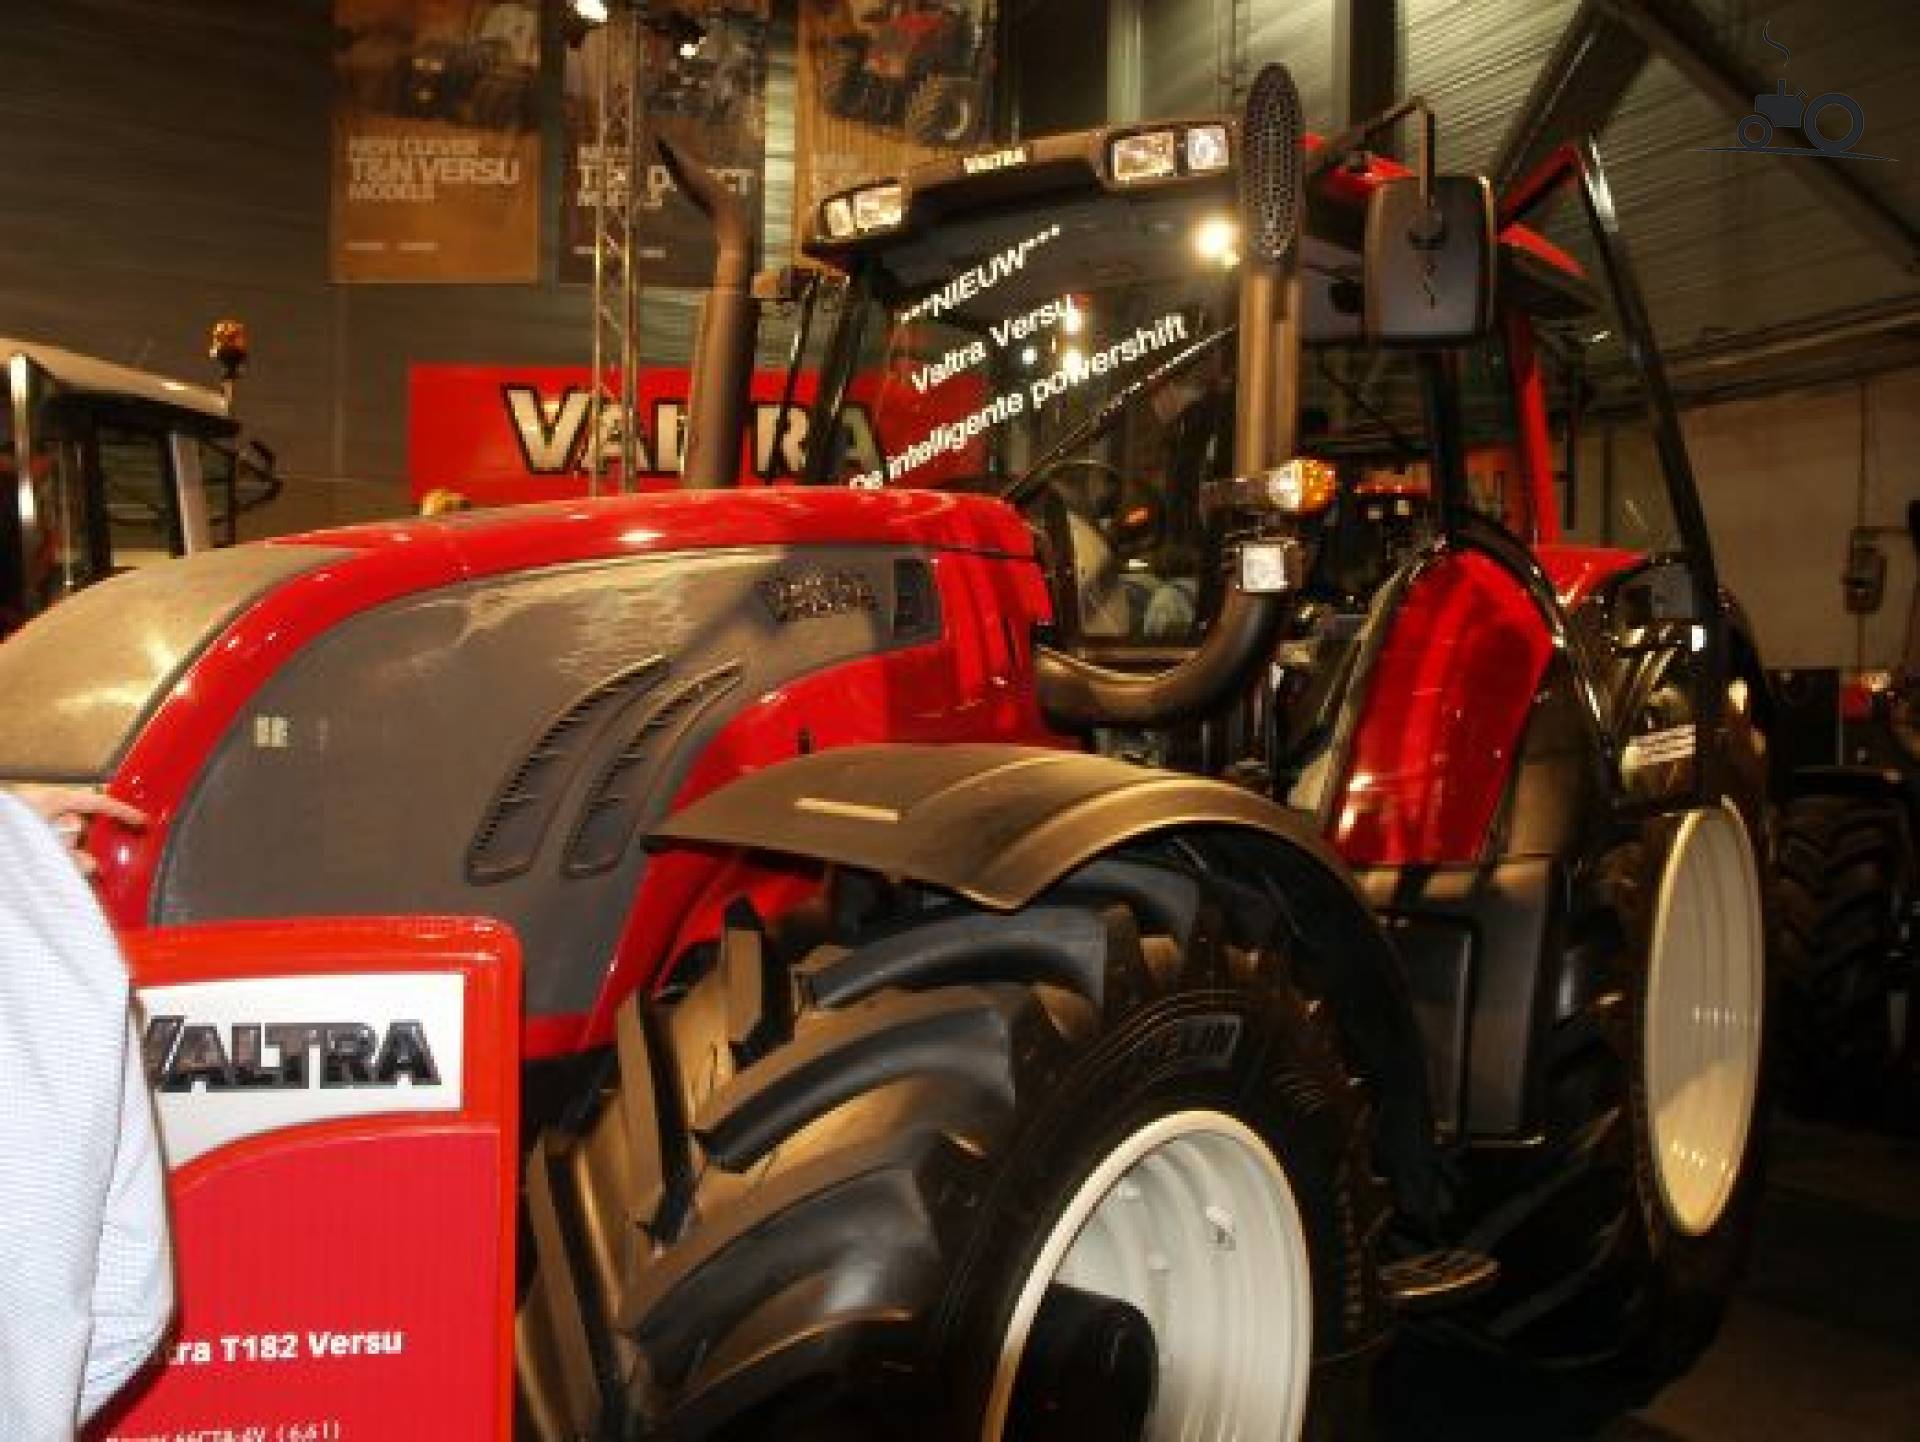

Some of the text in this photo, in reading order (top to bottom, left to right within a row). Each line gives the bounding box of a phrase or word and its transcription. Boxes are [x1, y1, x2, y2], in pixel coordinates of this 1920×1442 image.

[417, 158, 520, 184] VERSU
[911, 294, 1076, 394] Valtra Versu
[886, 393, 1023, 481] intelligente
[1029, 313, 1188, 410] powershift
[220, 1334, 299, 1362] T182
[307, 1330, 403, 1359] Versu
